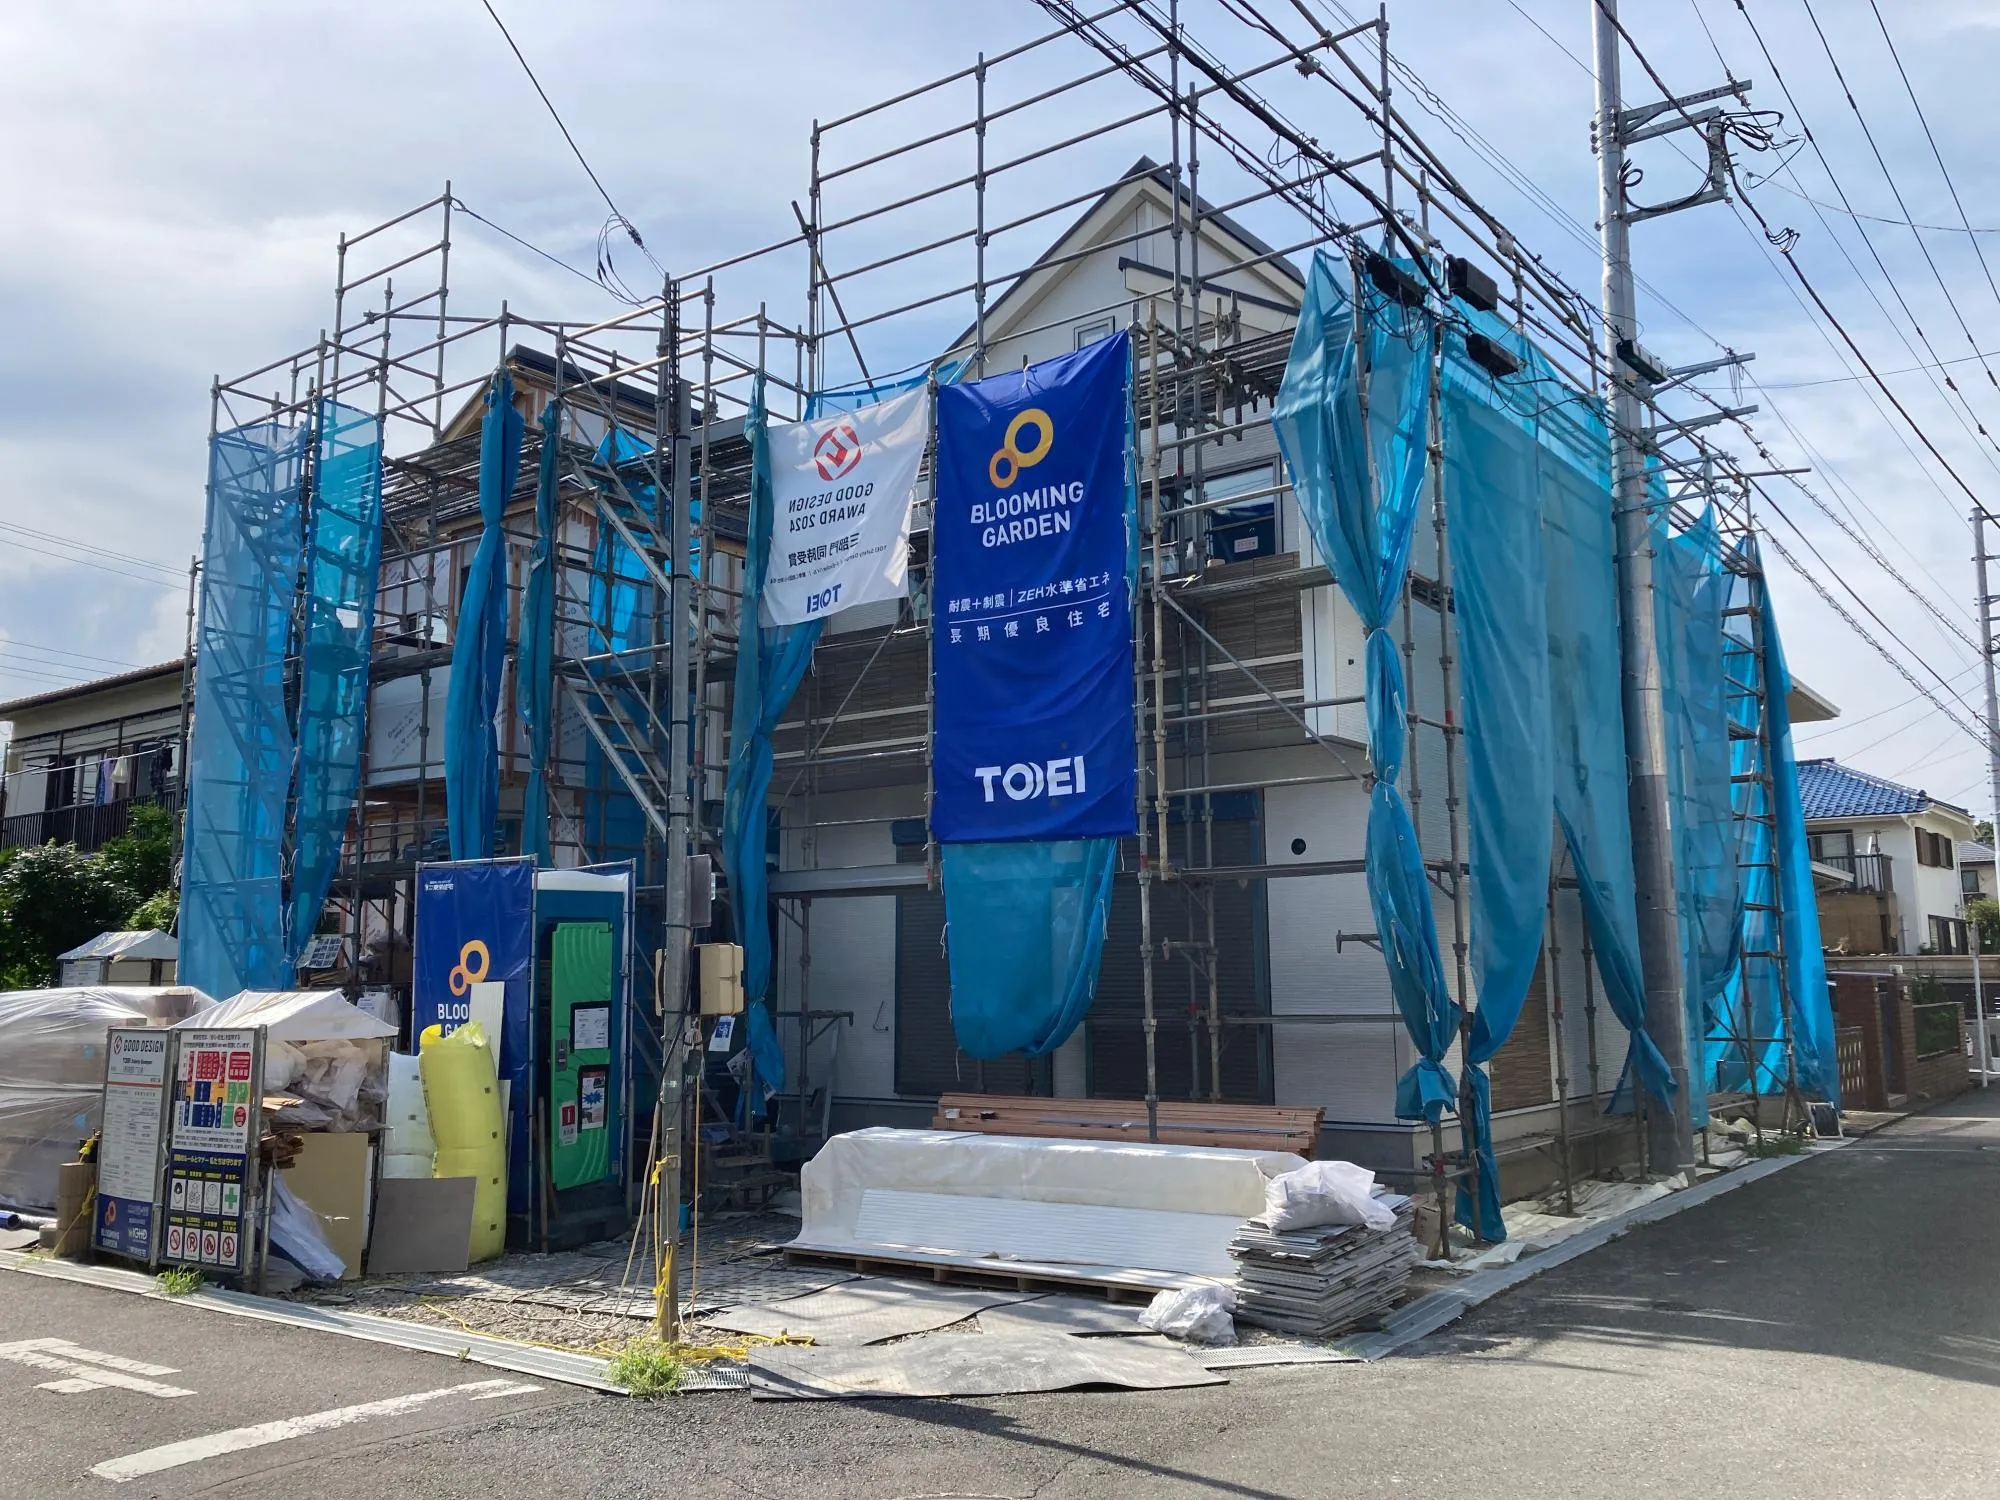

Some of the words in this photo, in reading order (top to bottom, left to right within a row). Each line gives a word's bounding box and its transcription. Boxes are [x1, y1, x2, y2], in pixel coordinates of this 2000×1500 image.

[970, 481, 1084, 524] BLOOMING
[982, 510, 1071, 548] GARDEN
[950, 601, 1111, 644] 長期優良住宅
[974, 755, 1086, 803] TOEI
[437, 1003, 469, 1020] BLOO
[123, 1039, 140, 1052] GOOD
[140, 1040, 164, 1053] DESIGN
